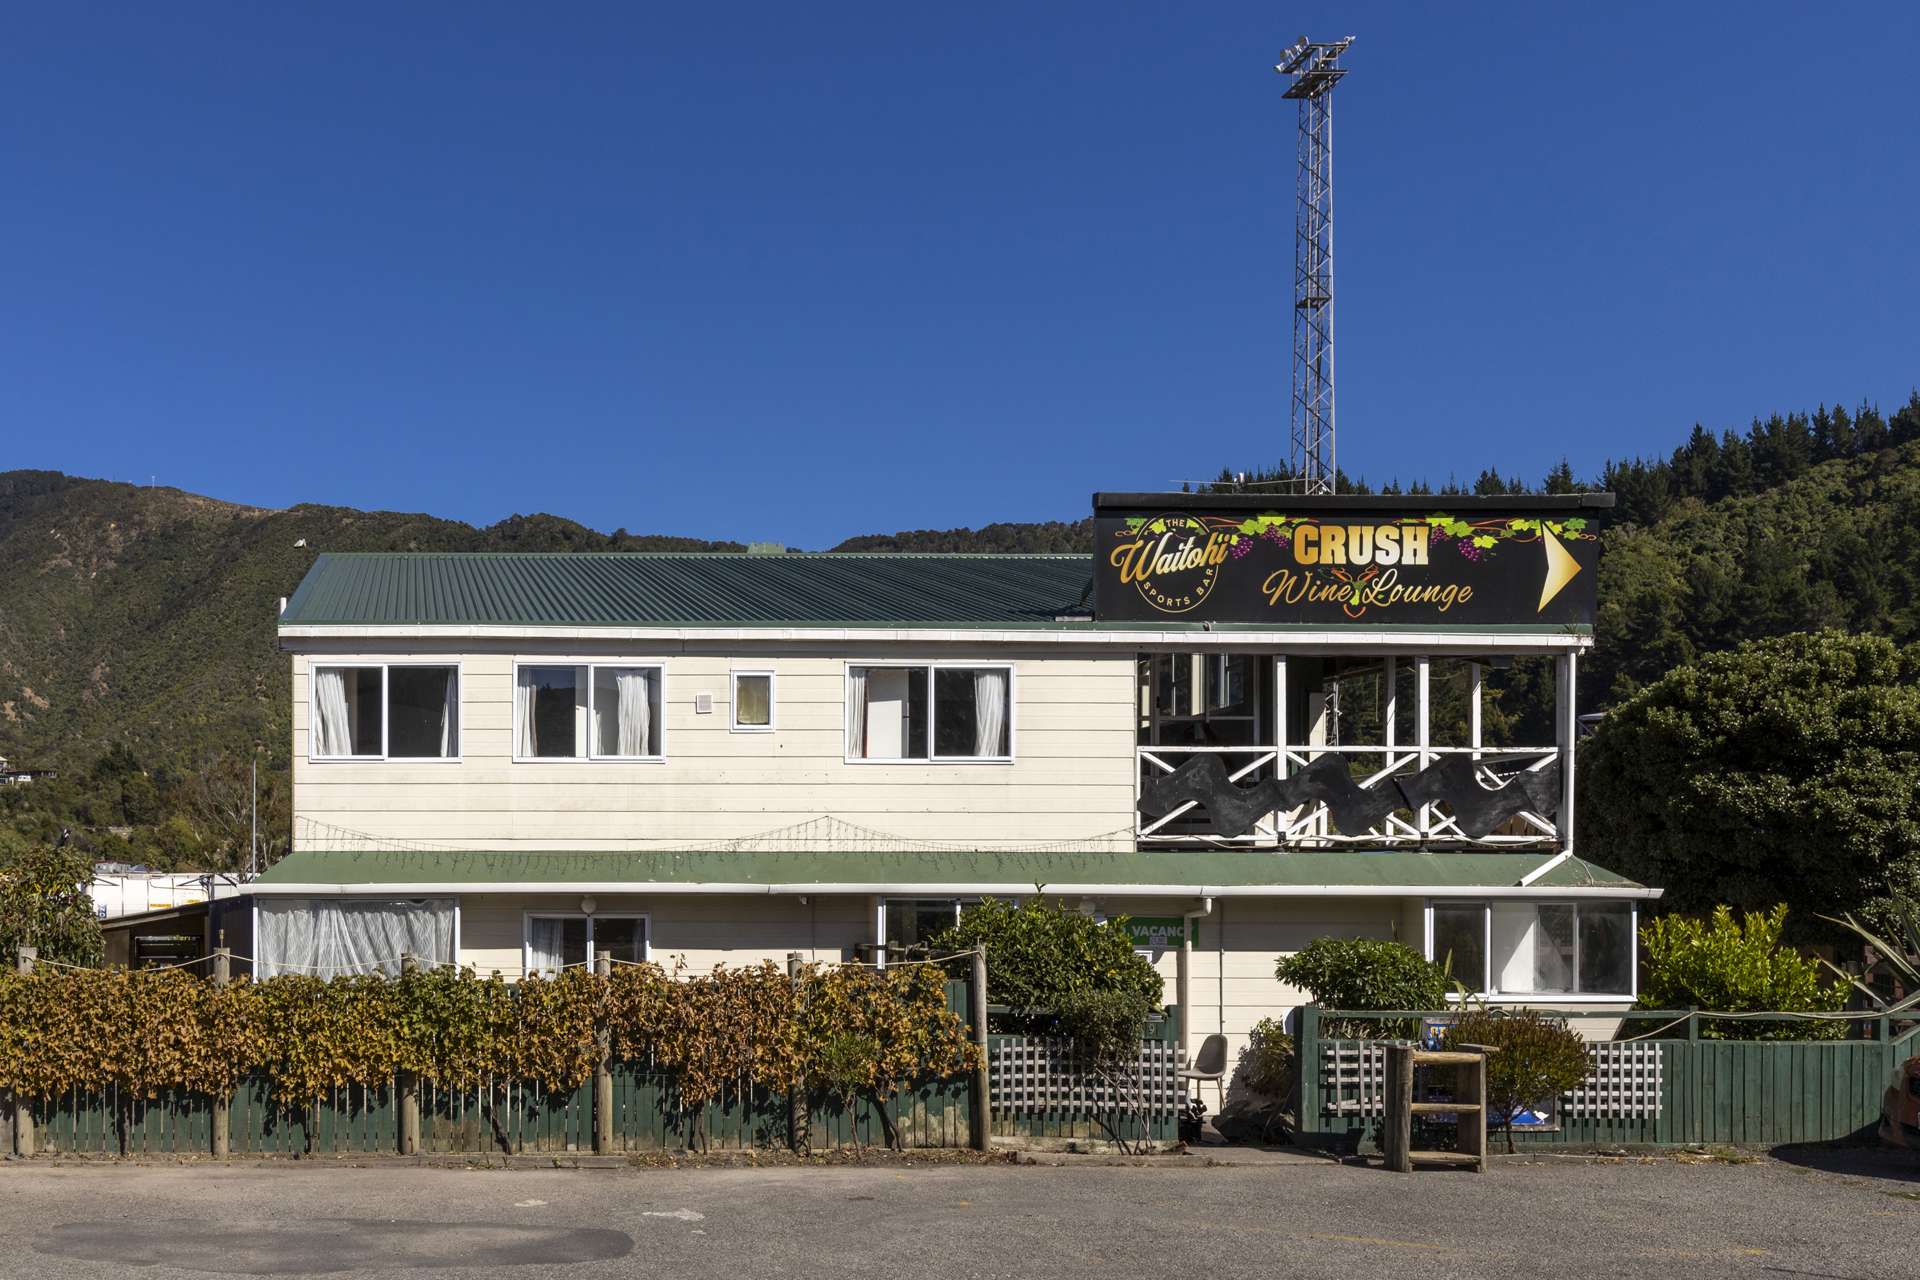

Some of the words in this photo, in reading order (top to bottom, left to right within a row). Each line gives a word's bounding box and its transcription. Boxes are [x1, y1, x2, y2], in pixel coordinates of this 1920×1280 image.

[1166, 519, 1185, 527] THE
[1110, 531, 1229, 584] Waitohi
[1293, 524, 1430, 566] CRUSH
[1143, 581, 1191, 607] SPORTS
[1196, 568, 1214, 596] BAR
[1262, 568, 1353, 606] Wine
[1362, 568, 1473, 612] Lounge
[1131, 925, 1191, 937] VACANC
